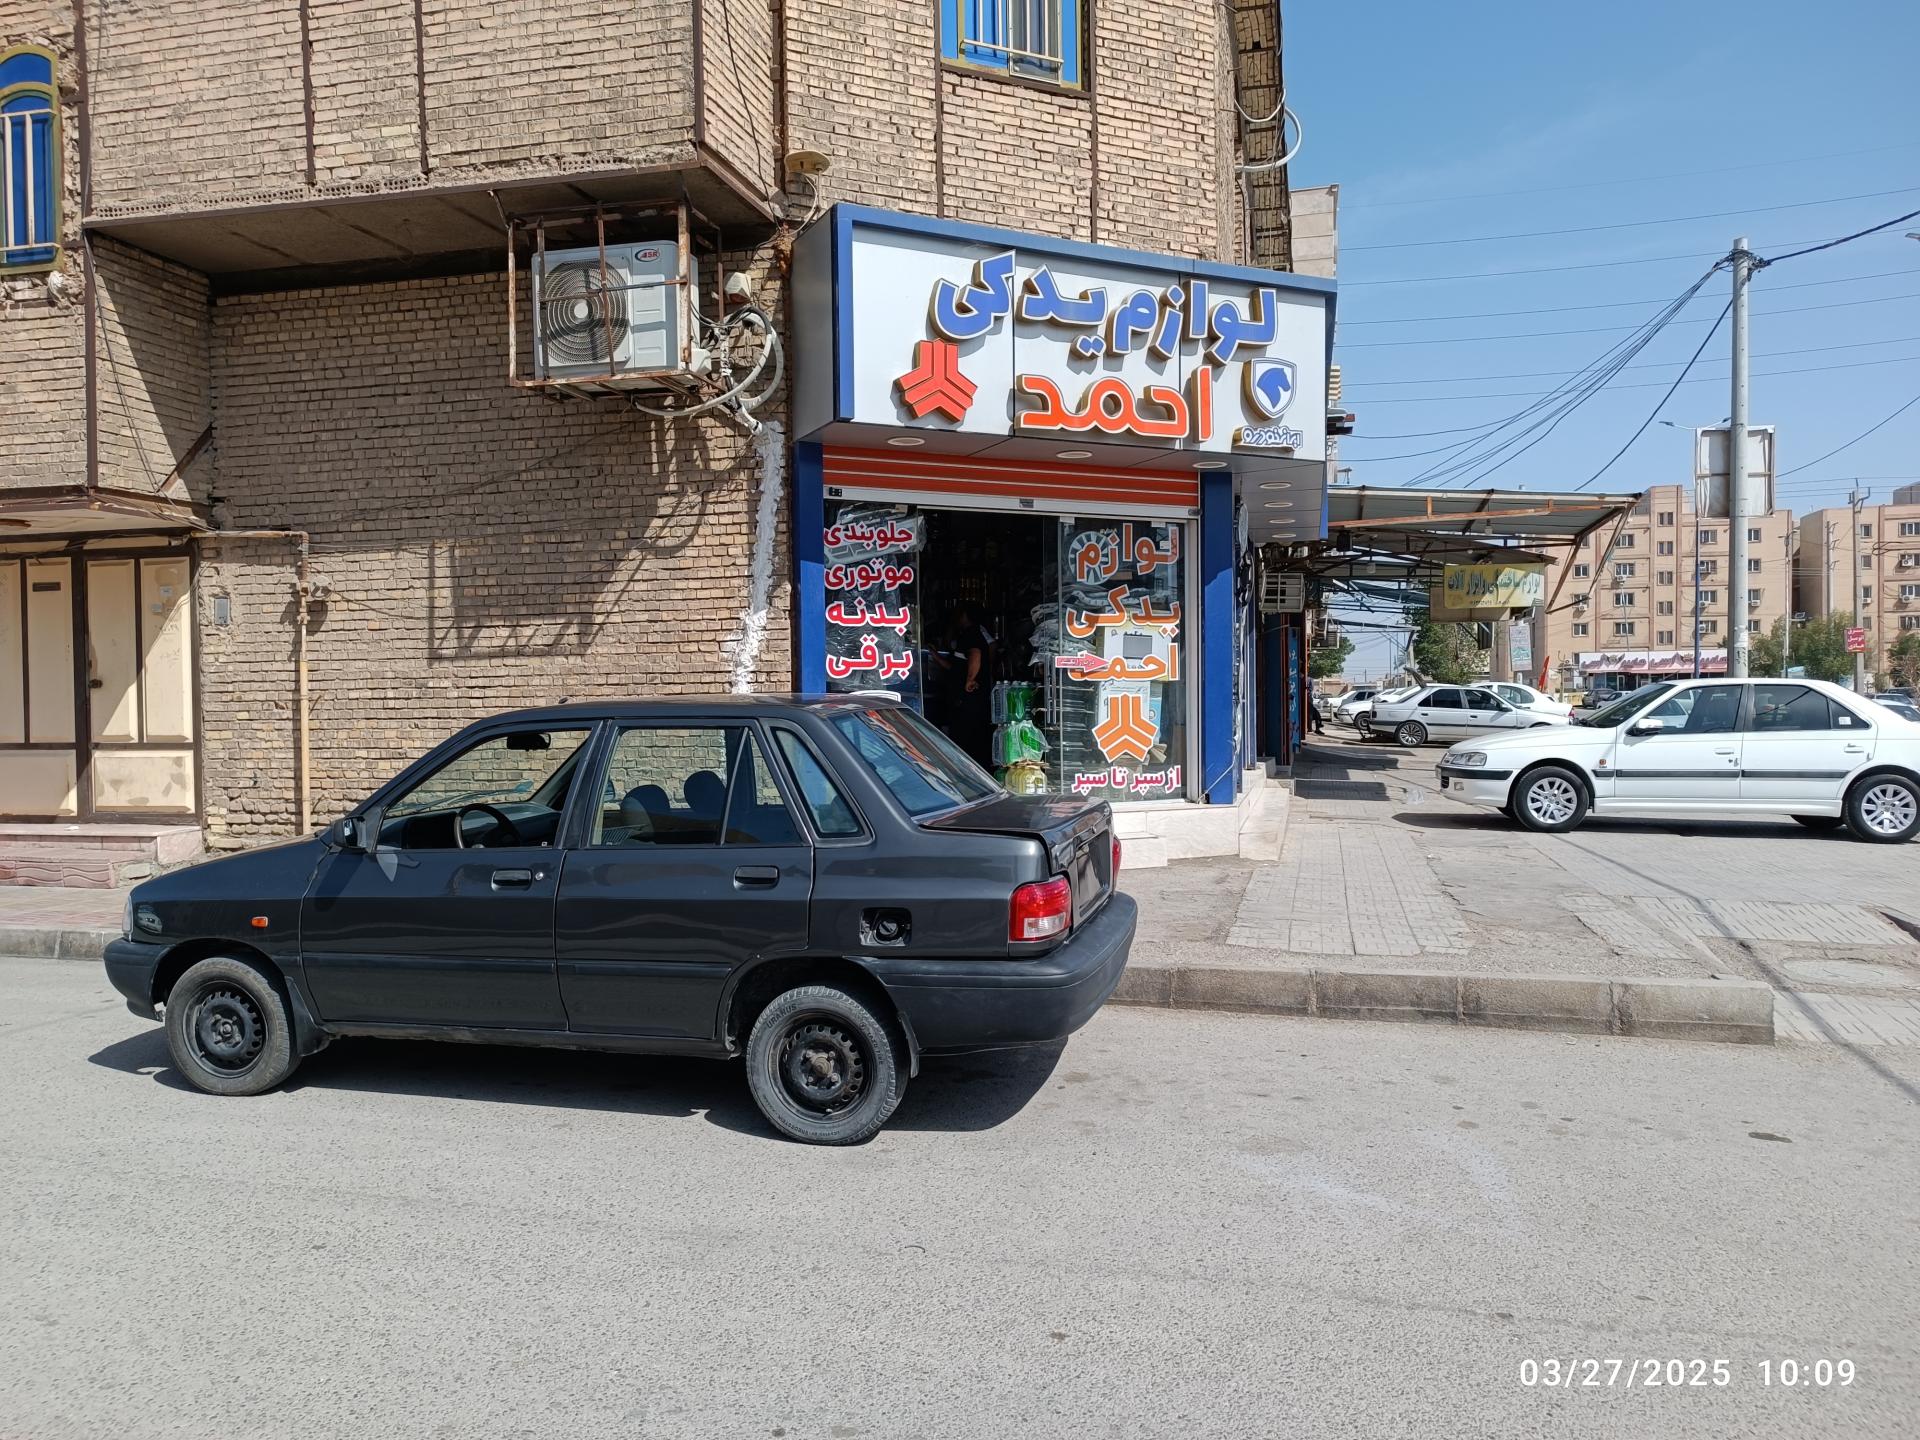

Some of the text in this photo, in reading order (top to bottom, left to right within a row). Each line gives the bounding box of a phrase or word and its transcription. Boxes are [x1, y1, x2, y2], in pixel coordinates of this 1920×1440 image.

[930, 250, 1278, 366] لوازم یدکی
[1015, 366, 1215, 442] احمد
[823, 521, 914, 551] جلوبندی
[1076, 523, 1179, 581] لوازم
[824, 557, 914, 590] موتوری
[825, 597, 910, 636] بدنه
[1066, 584, 1181, 638] یدکی
[826, 634, 913, 680] برقی
[1071, 765, 1181, 796] از سپر تا سپر
